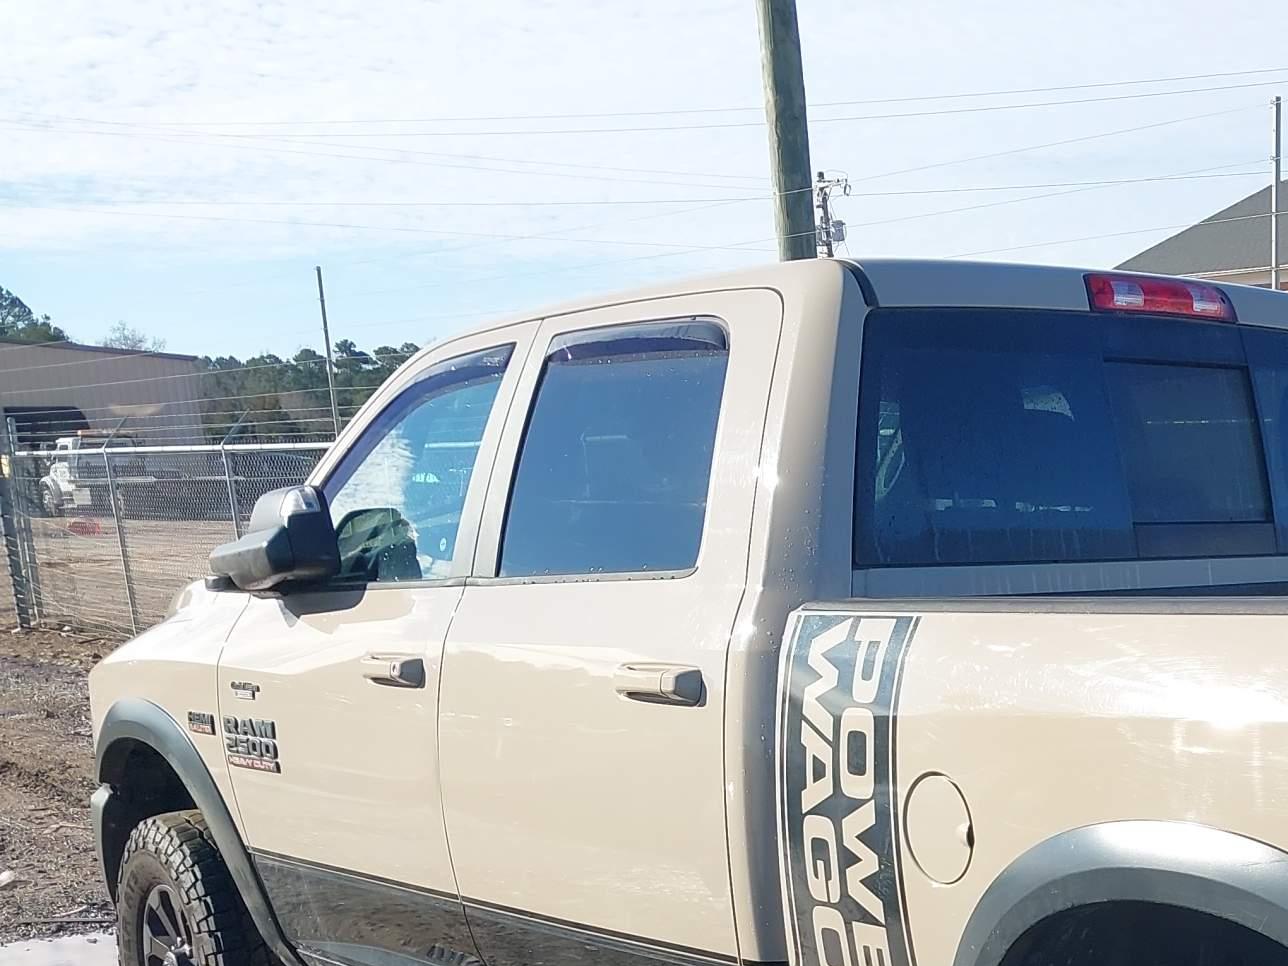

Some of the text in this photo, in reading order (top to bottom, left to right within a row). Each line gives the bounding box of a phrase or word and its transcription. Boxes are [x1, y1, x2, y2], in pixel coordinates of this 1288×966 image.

[188, 711, 212, 725] HEMI
[223, 714, 276, 740] RAM
[225, 736, 279, 760] 2500
